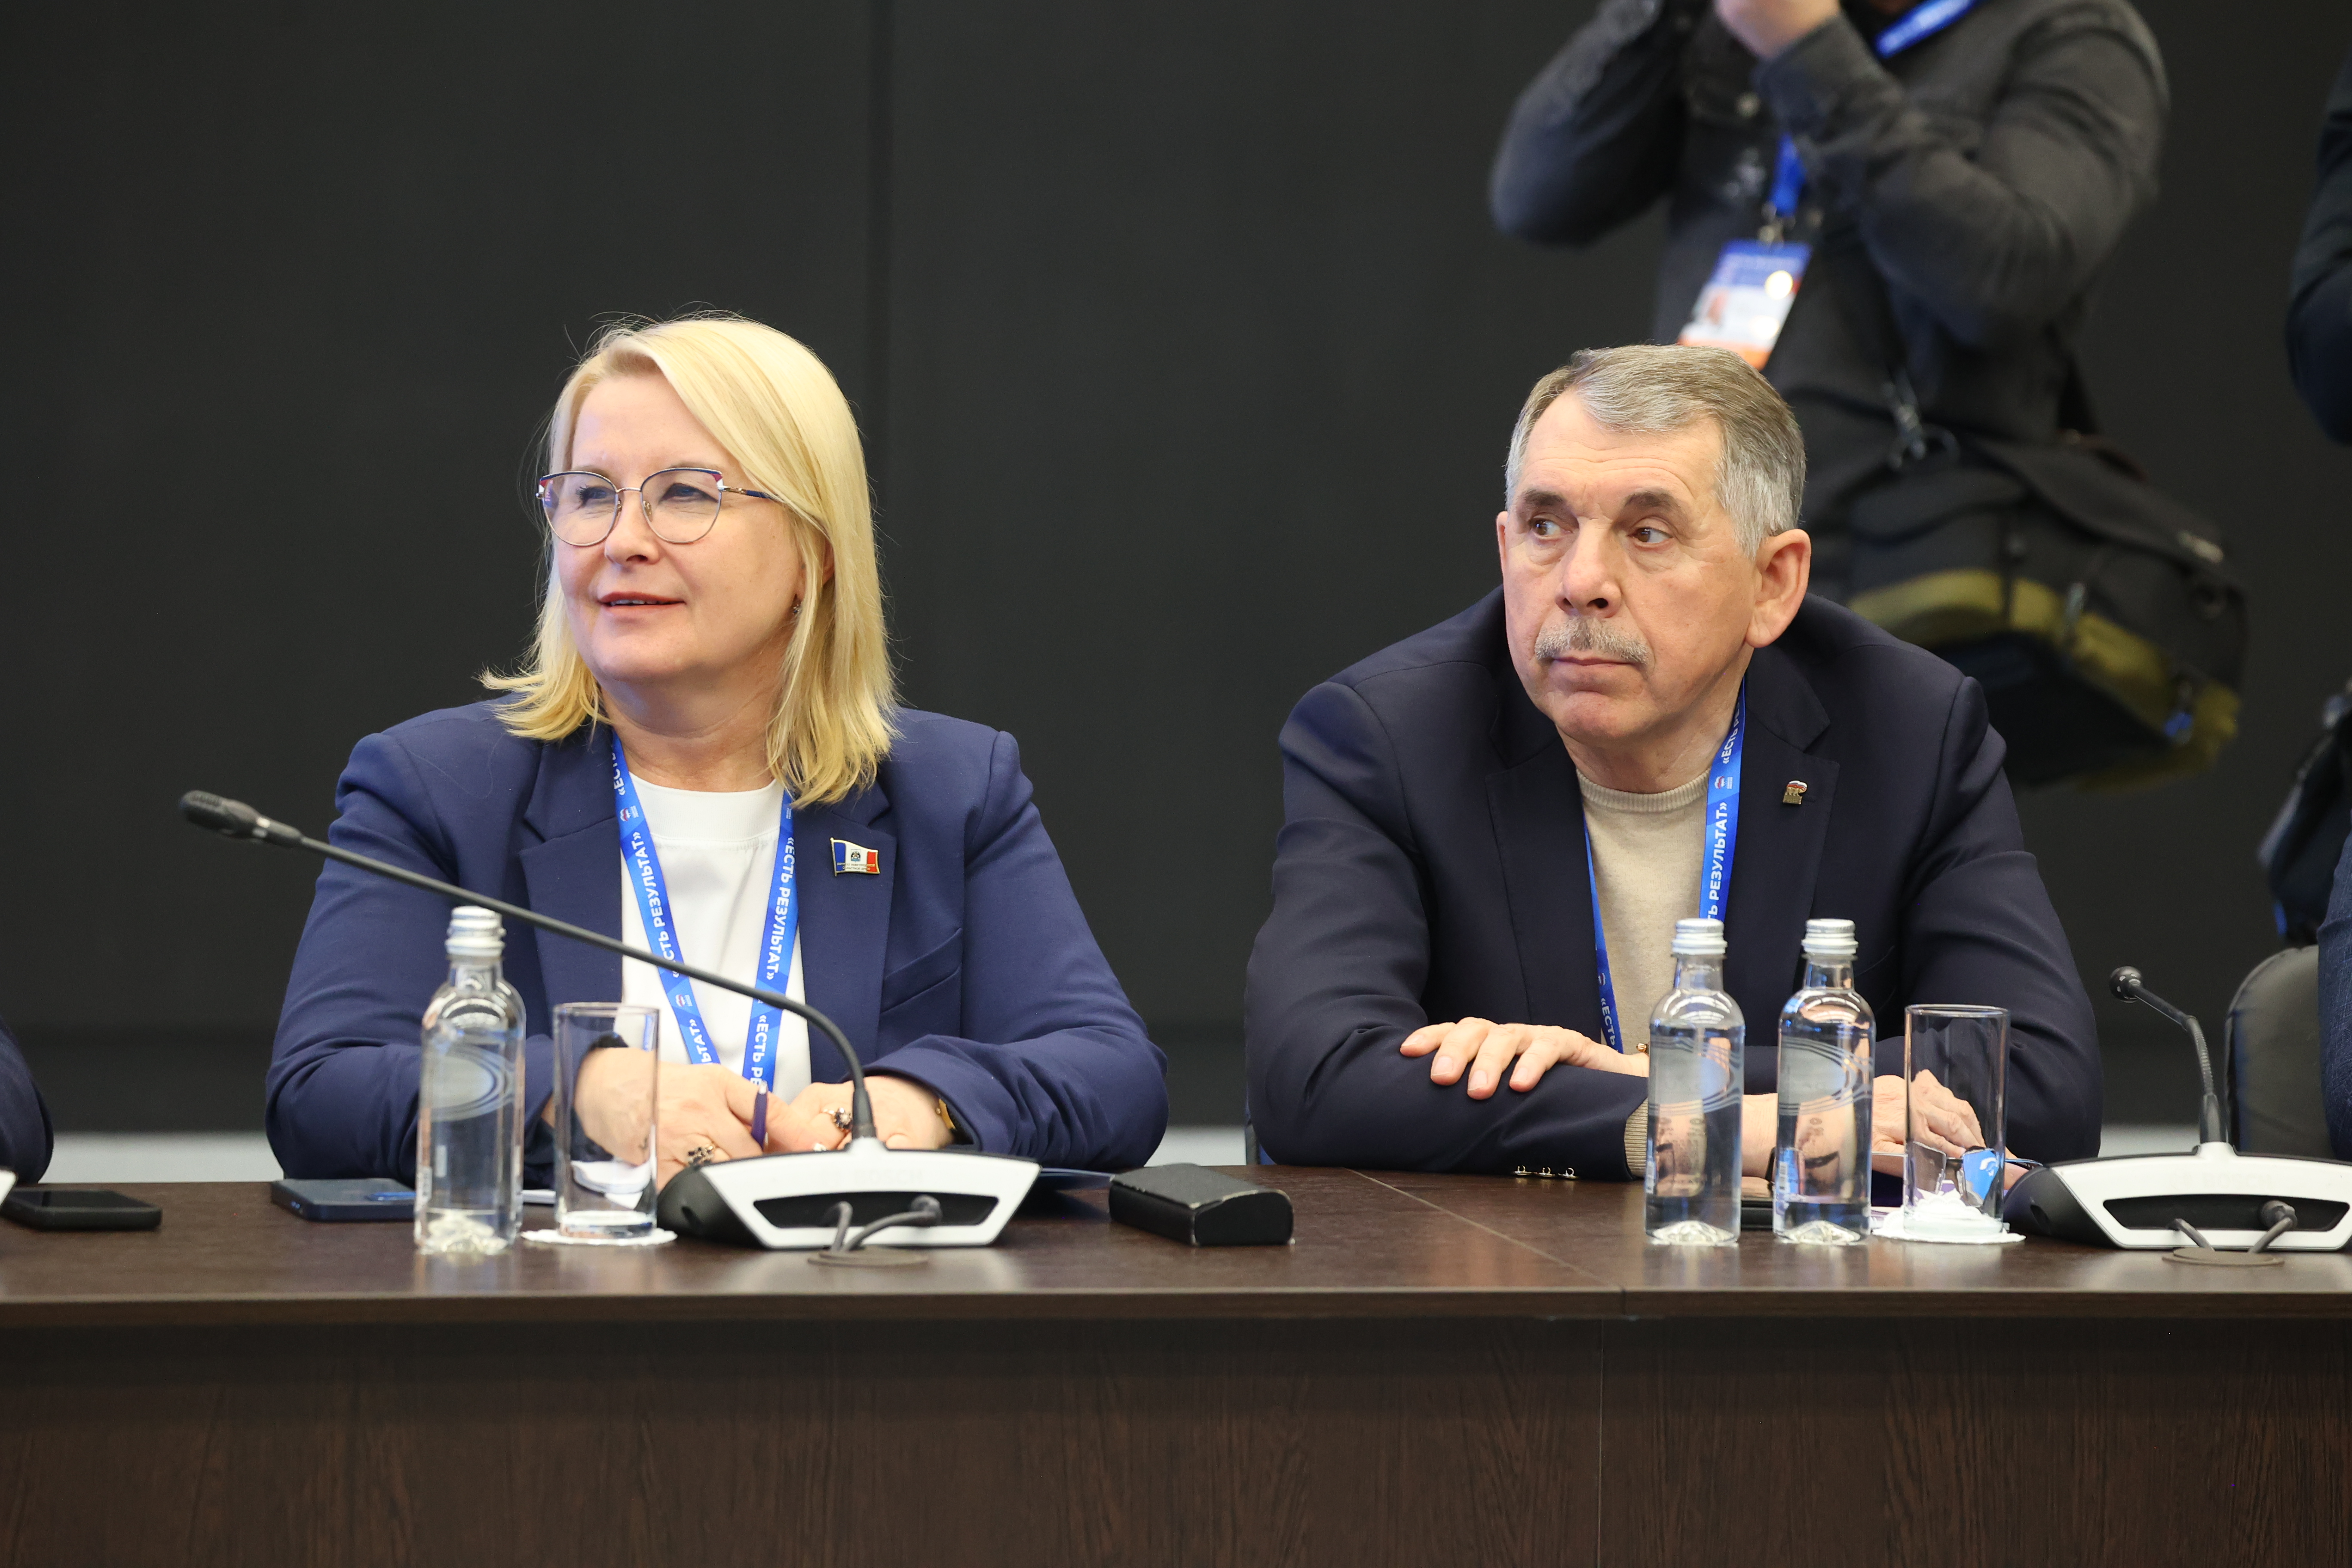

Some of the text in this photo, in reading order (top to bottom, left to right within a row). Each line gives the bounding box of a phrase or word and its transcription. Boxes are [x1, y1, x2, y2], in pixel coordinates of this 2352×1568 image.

[1709, 802, 1728, 900] РЕЗУЛЬТАТ»
[631, 831, 680, 978] «СТЬ РЕЗУЛЬТАТ»
[766, 837, 795, 980] «ЕСТЬ РЕЗУЛЬТАТ»
[689, 1019, 712, 1063] ЬТАТ»
[753, 1015, 769, 1063] «ЕСТЬ
[1601, 998, 1616, 1045] «ЕСТЬ
